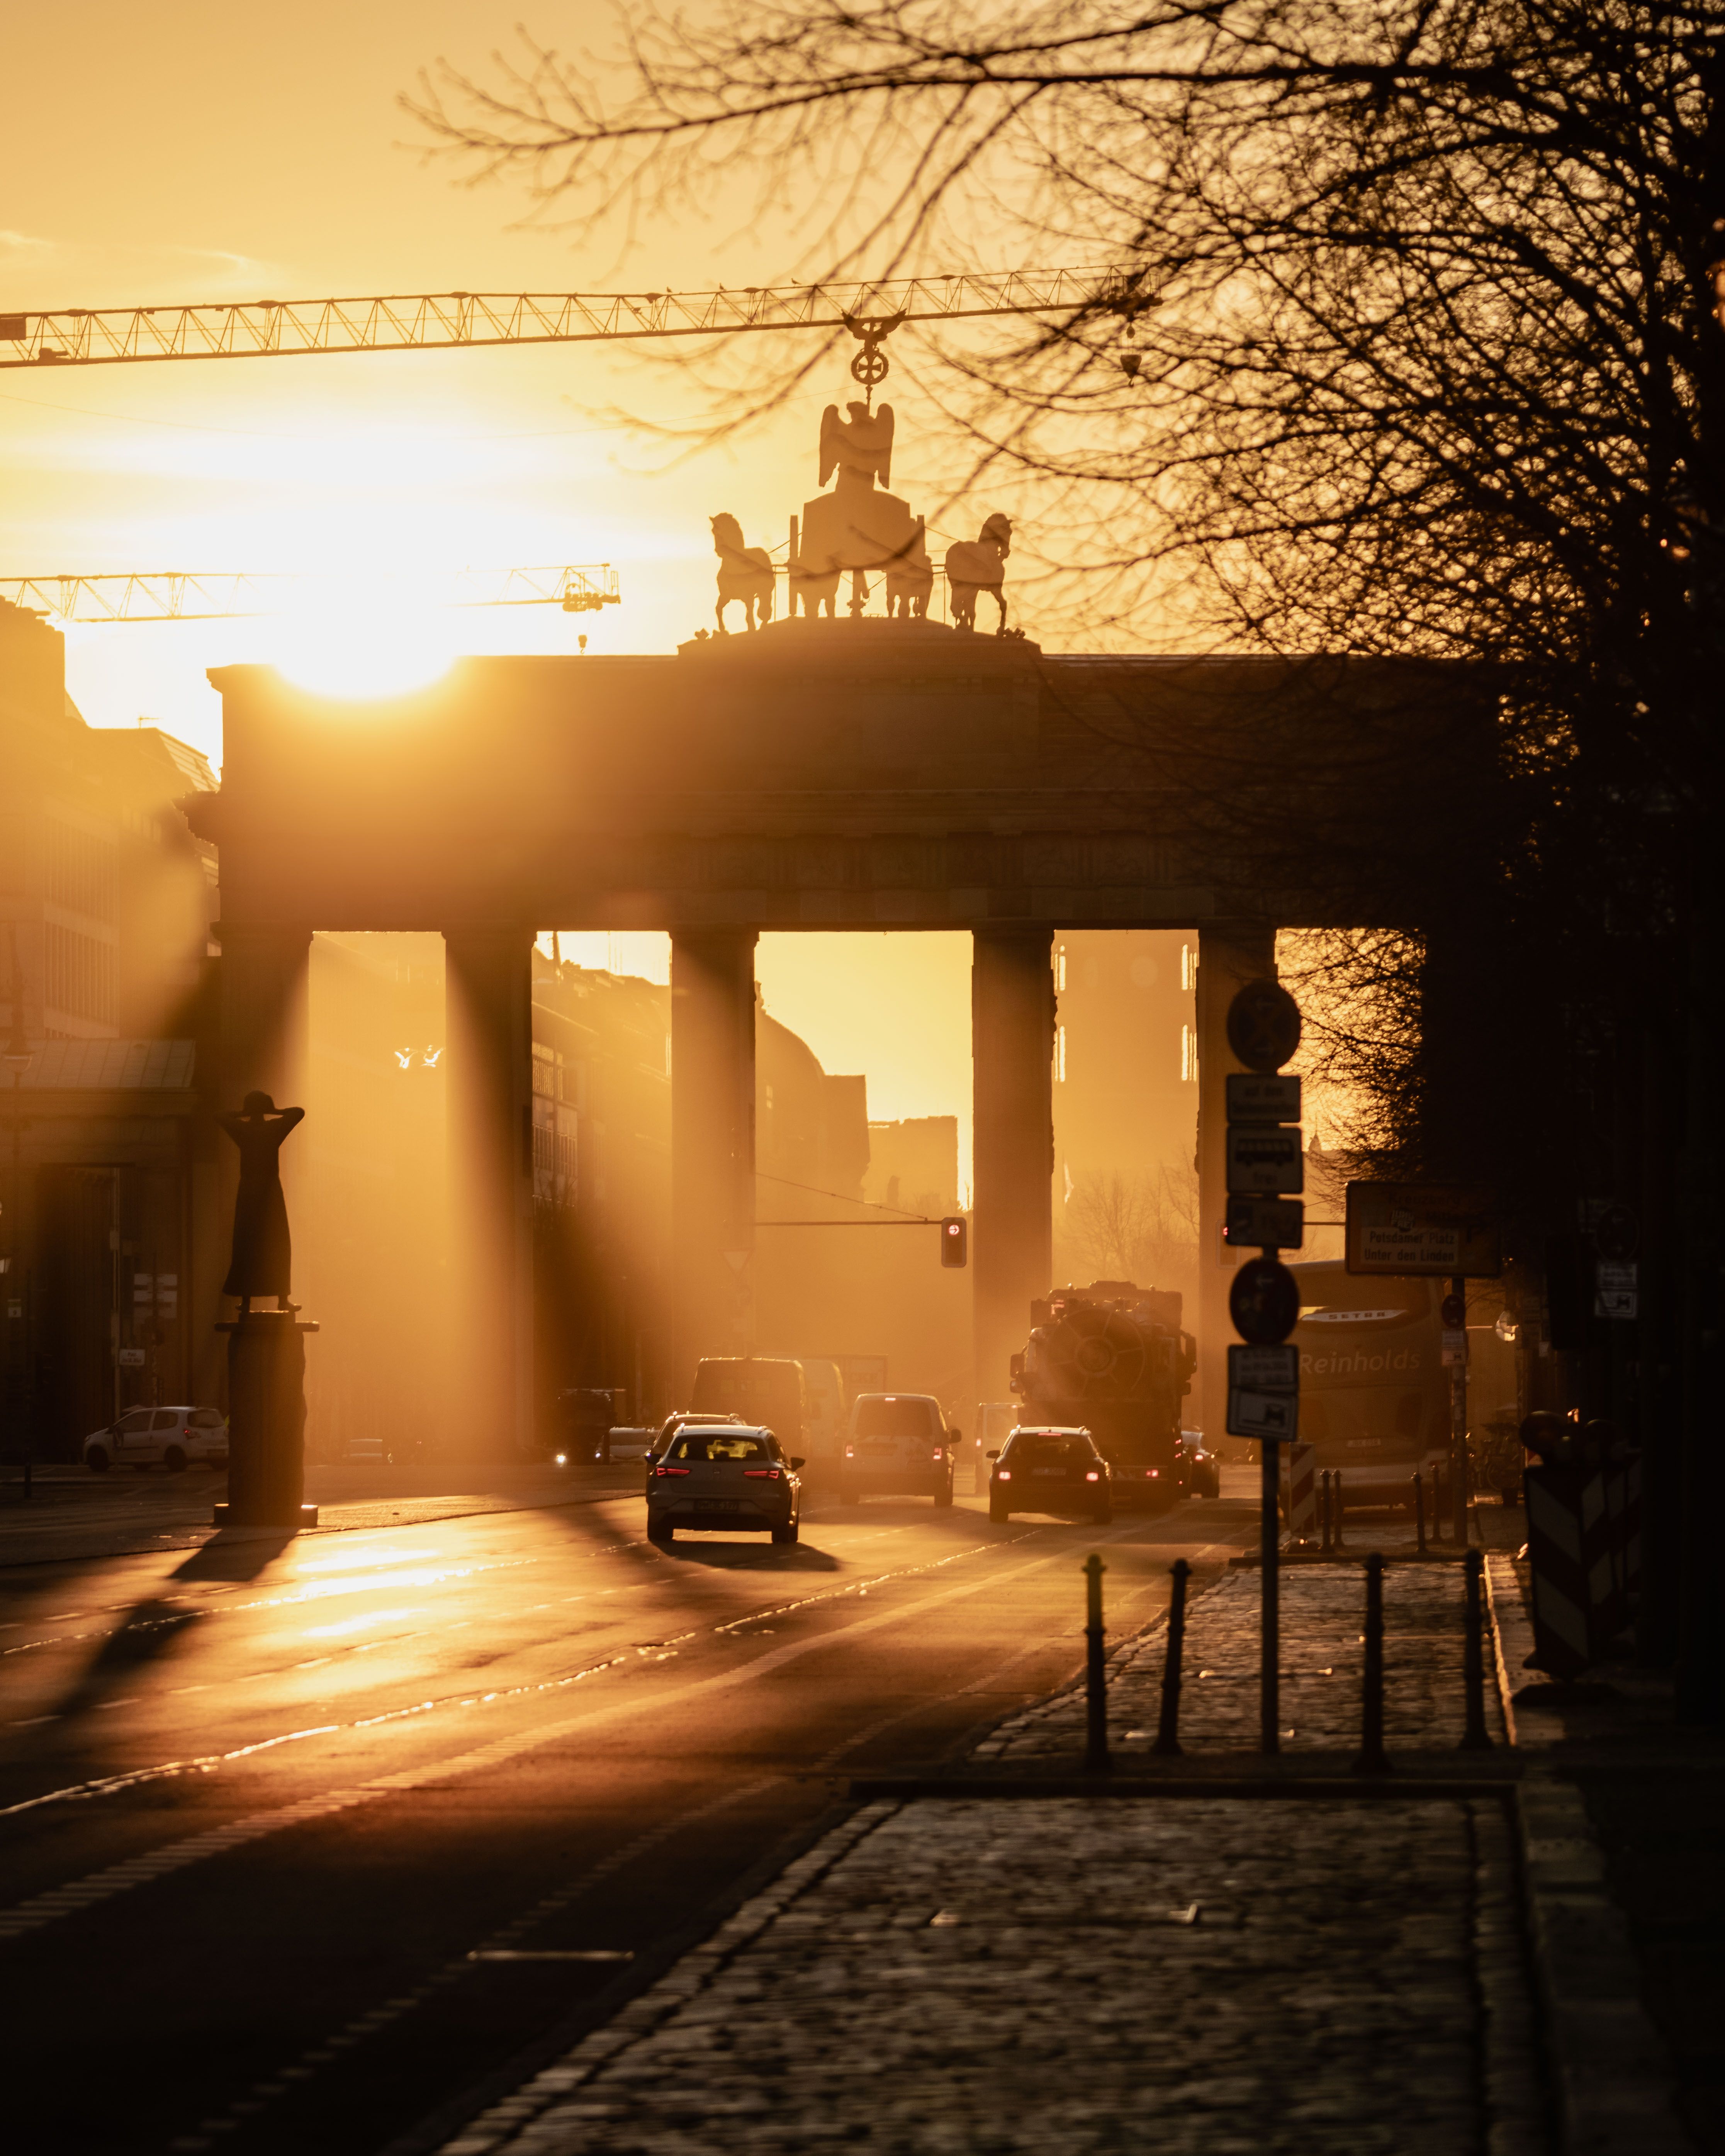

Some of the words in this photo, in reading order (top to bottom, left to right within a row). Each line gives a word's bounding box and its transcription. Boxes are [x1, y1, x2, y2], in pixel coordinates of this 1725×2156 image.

[1388, 1193, 1460, 1208] Kreuzberg
[1370, 1231, 1424, 1244] Potsdamer
[1429, 1232, 1455, 1244] Platz
[1365, 1248, 1392, 1260] Unter
[1397, 1249, 1416, 1261] den
[1421, 1249, 1454, 1262] Linden
[1329, 1311, 1385, 1320] SETRA
[1299, 1348, 1421, 1375] Reinholds
